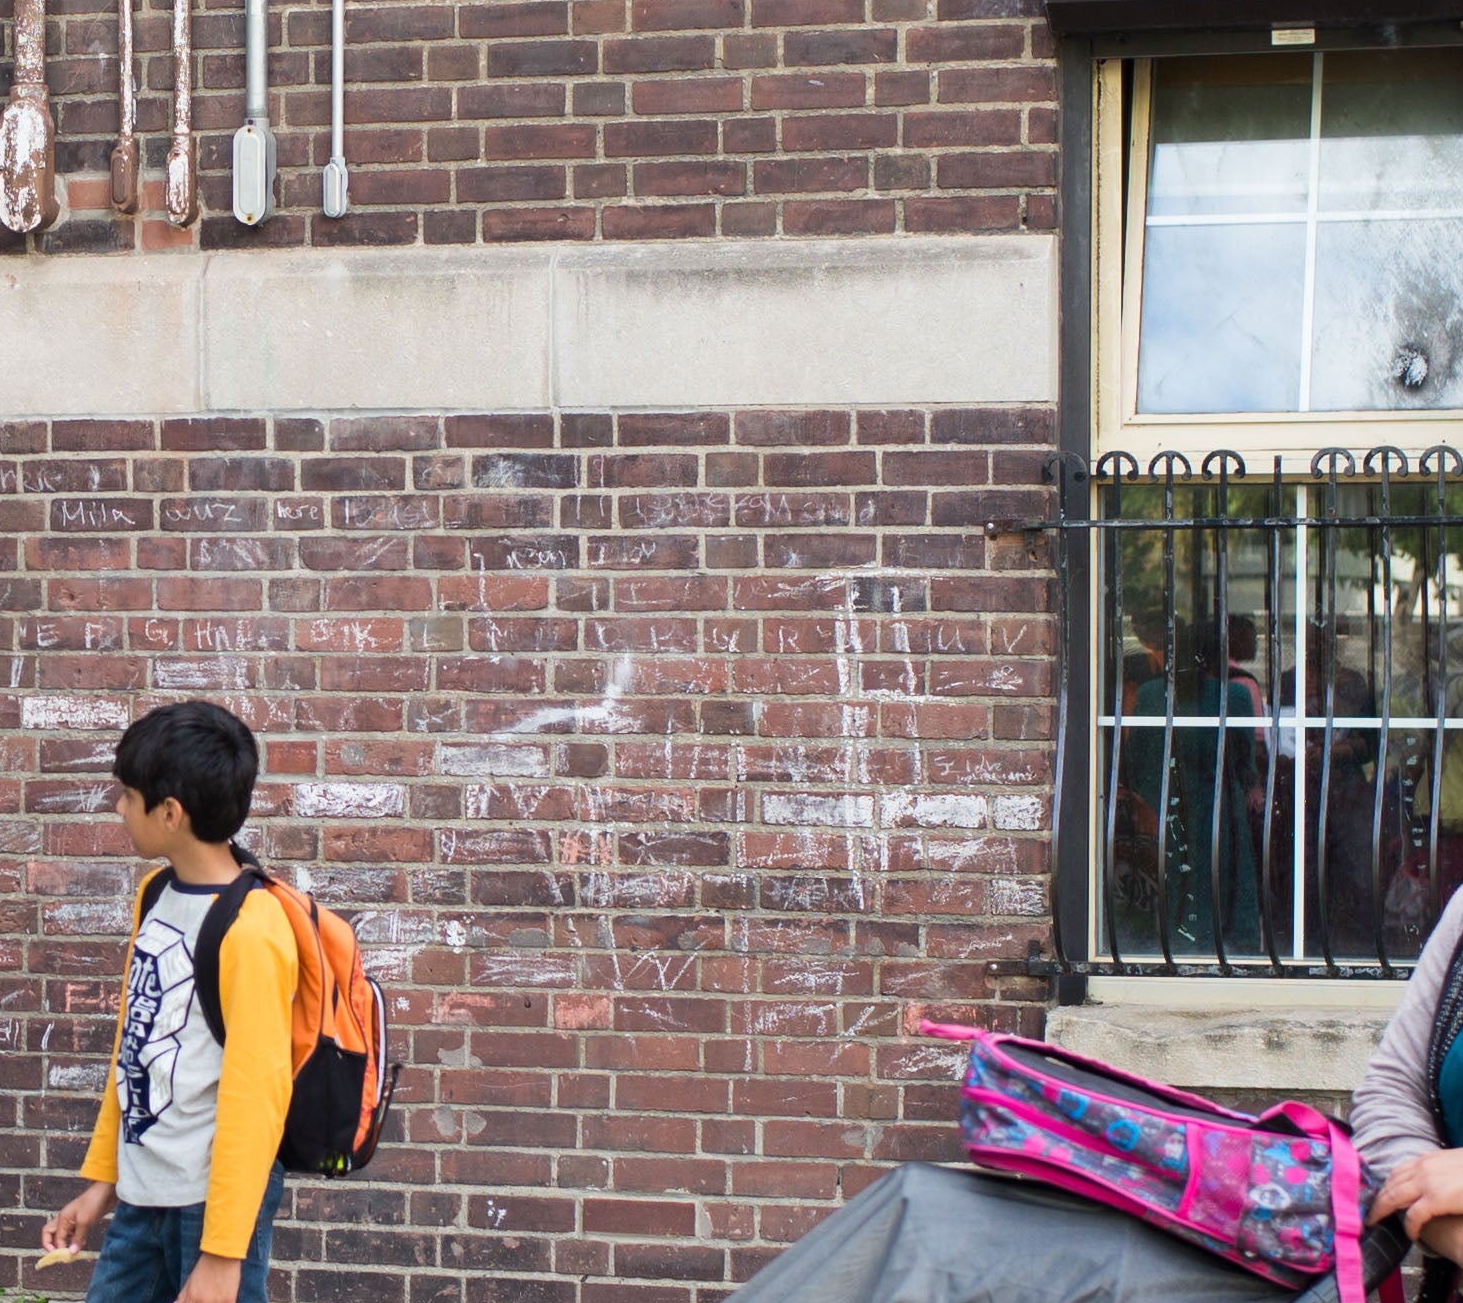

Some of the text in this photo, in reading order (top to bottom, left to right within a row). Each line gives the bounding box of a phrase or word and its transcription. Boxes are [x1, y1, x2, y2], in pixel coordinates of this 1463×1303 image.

[61, 501, 137, 527] Mila
[276, 501, 319, 520] here
[129, 955, 162, 998] ate
